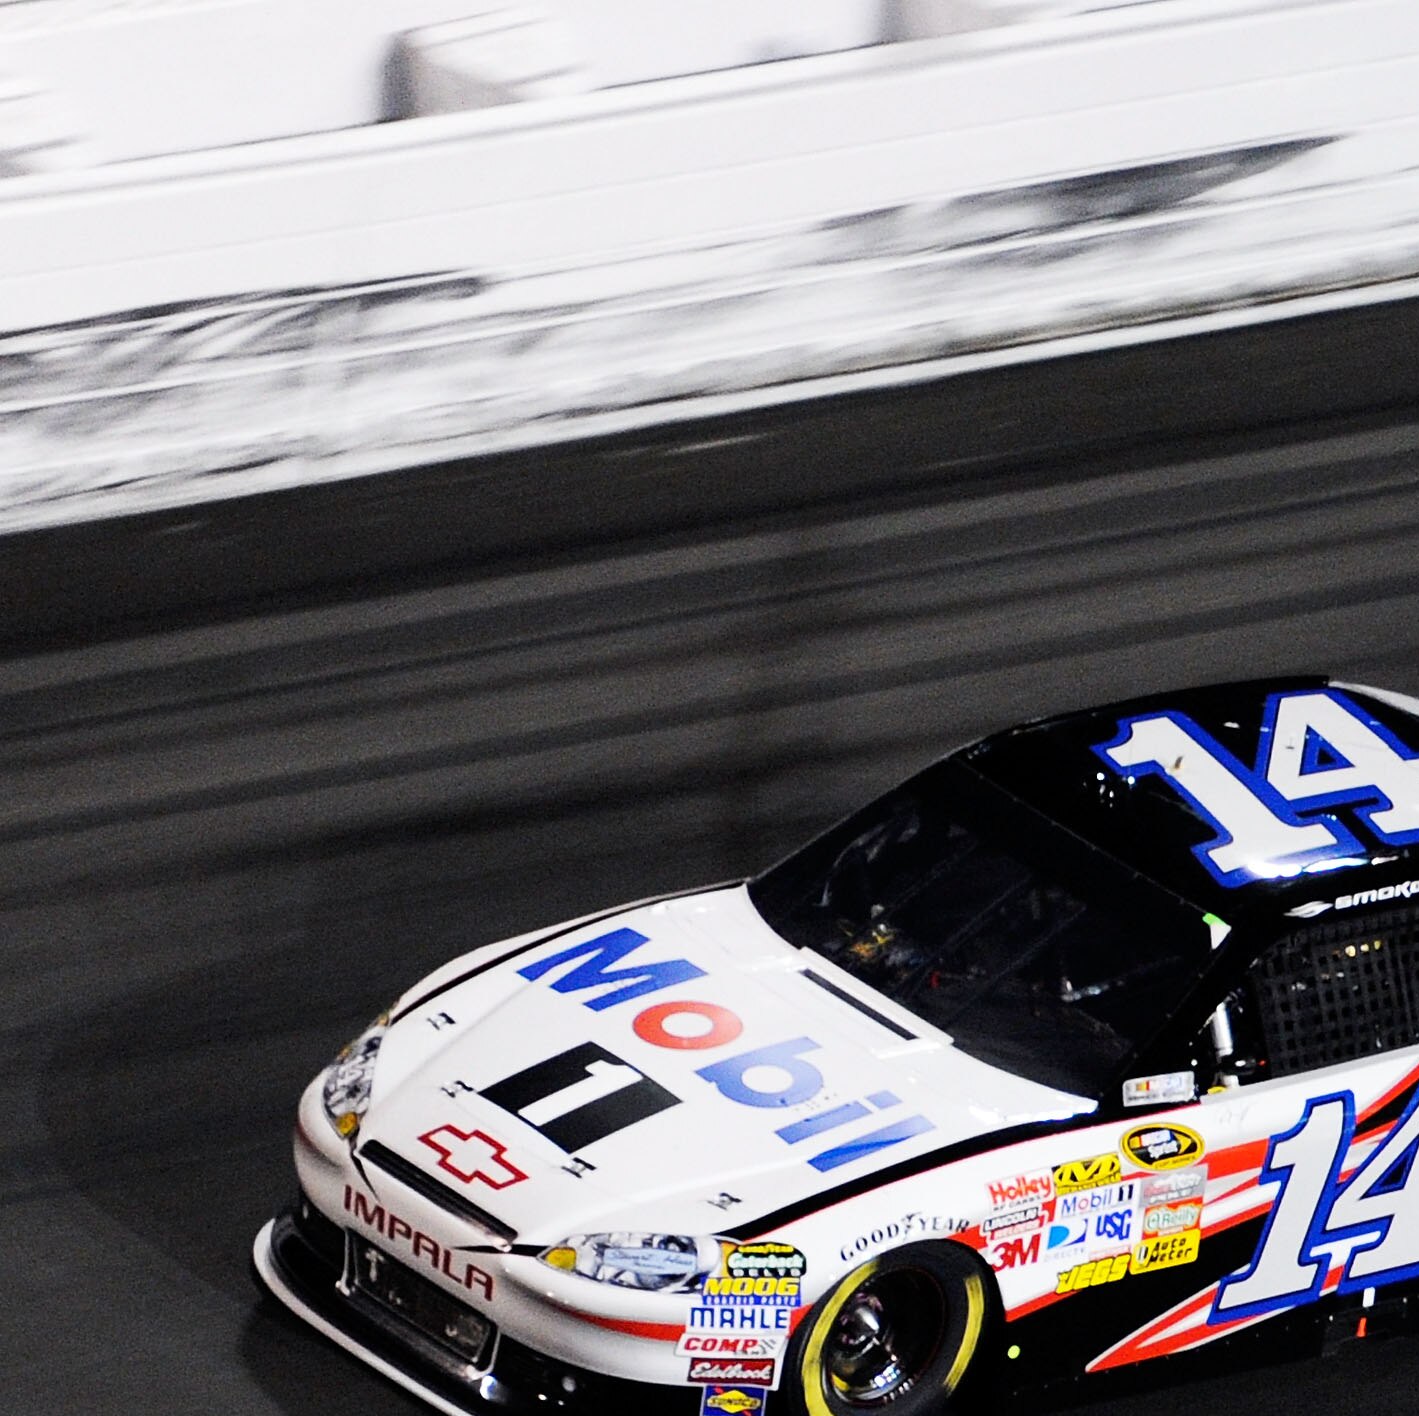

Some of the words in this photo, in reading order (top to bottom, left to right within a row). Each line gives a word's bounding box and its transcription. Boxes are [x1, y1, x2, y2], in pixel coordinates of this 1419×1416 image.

[516, 927, 937, 1173] Mobil
[990, 1174, 1051, 1204] Holley
[1061, 1189, 1112, 1216] Mobil
[840, 1212, 971, 1262] GOODYEAR
[1096, 1209, 1132, 1240] USG
[343, 1184, 494, 1300] IMPALA
[991, 1232, 1041, 1271] 3M
[1149, 1248, 1193, 1262] Meter
[1153, 1237, 1187, 1252] Auto
[704, 1278, 799, 1297] MOOG
[1056, 1253, 1131, 1294] JEGS
[690, 1308, 787, 1329] MAHLE
[684, 1337, 758, 1351] COMP
